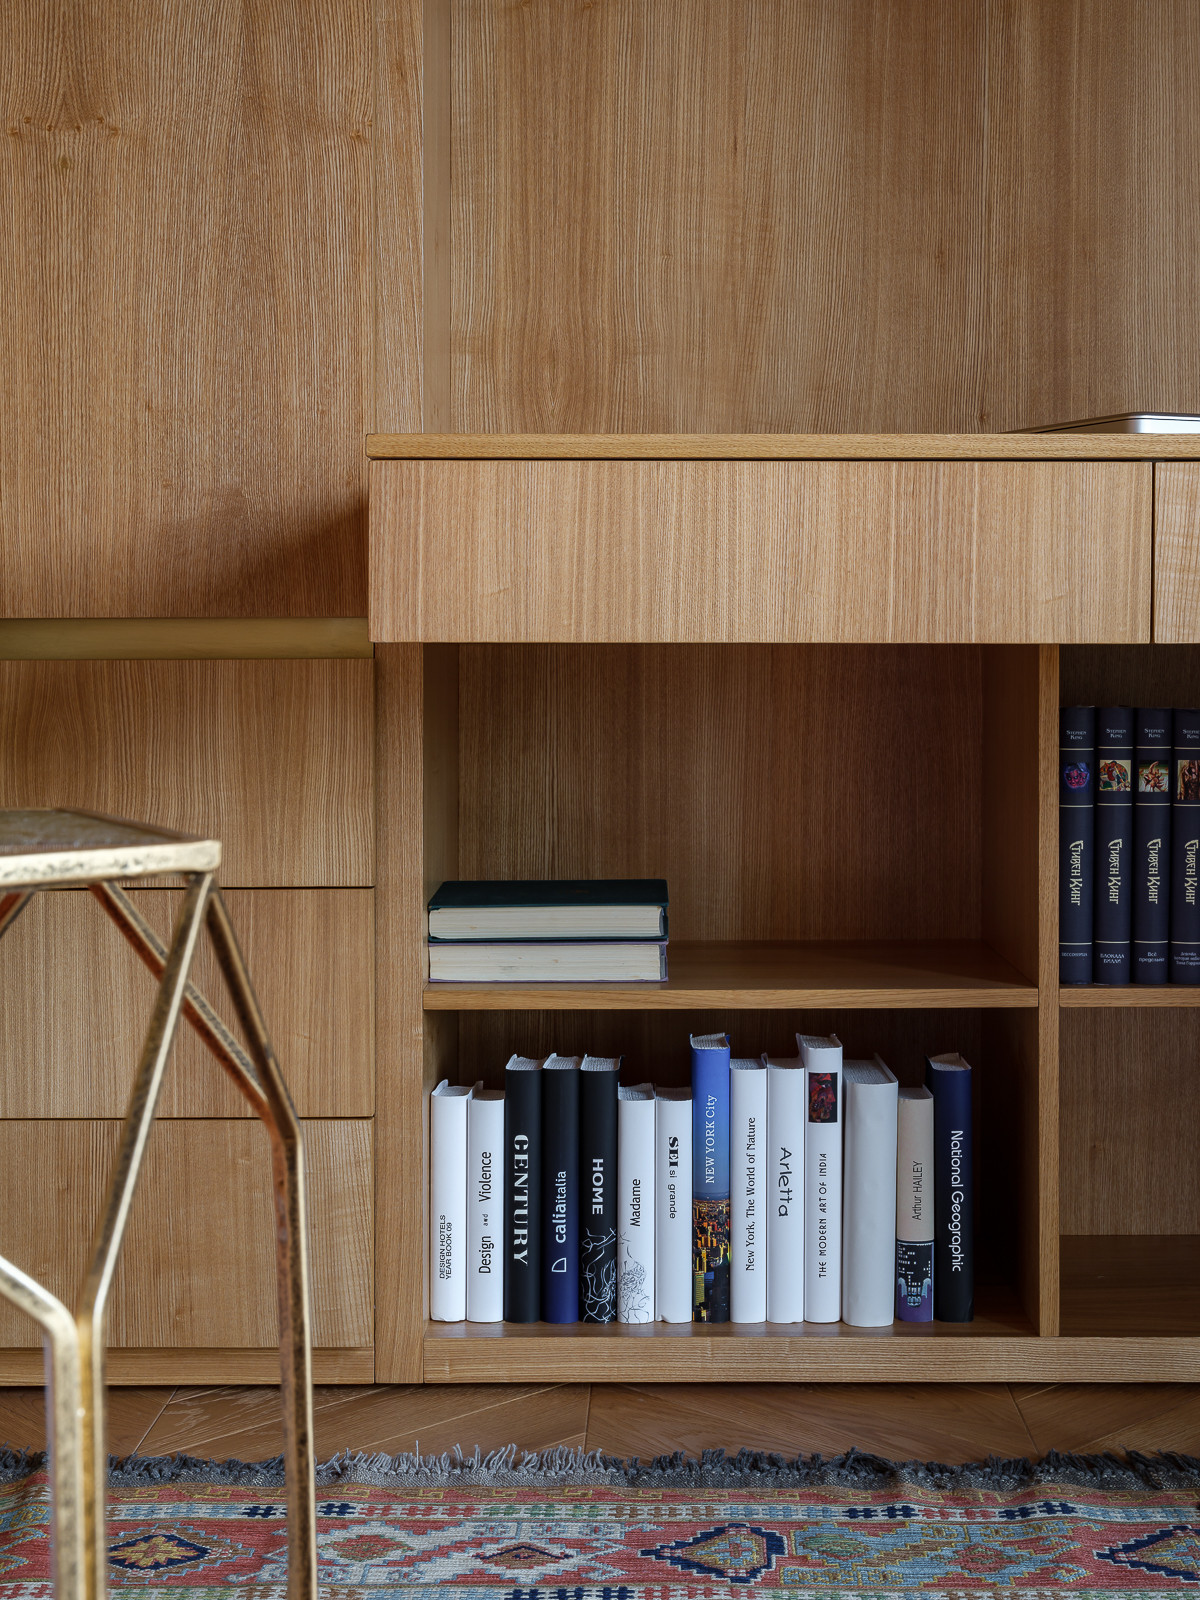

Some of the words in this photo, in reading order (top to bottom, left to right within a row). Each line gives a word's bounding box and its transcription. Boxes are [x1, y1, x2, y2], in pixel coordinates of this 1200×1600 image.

[705, 1094, 718, 1119] City
[705, 1120, 715, 1155] YORK
[746, 1117, 756, 1151] Nature
[668, 1136, 680, 1168] SEI
[746, 1152, 756, 1164] of
[818, 1153, 827, 1177] INDIA
[950, 1130, 964, 1188] National
[478, 1151, 492, 1203] Violence
[669, 1169, 678, 1179] si
[705, 1156, 715, 1184] NEW
[746, 1166, 756, 1197] World
[778, 1146, 793, 1217] Arletta
[912, 1160, 923, 1193] HAILEY
[513, 1134, 529, 1266] CENTURY
[592, 1158, 604, 1215] HOME
[629, 1178, 641, 1227] Madame
[667, 1183, 678, 1219] grande
[818, 1181, 827, 1195] OF
[552, 1170, 567, 1244] caliaitalia
[746, 1198, 756, 1219] The
[818, 1196, 827, 1214] ART
[911, 1195, 922, 1221] Arthur
[445, 1222, 453, 1232] 09
[745, 1221, 756, 1248] York,
[818, 1218, 827, 1257] MODERN
[948, 1190, 965, 1272] Geographic
[478, 1235, 495, 1274] Design
[745, 1249, 755, 1272] New
[818, 1261, 828, 1279] THE
